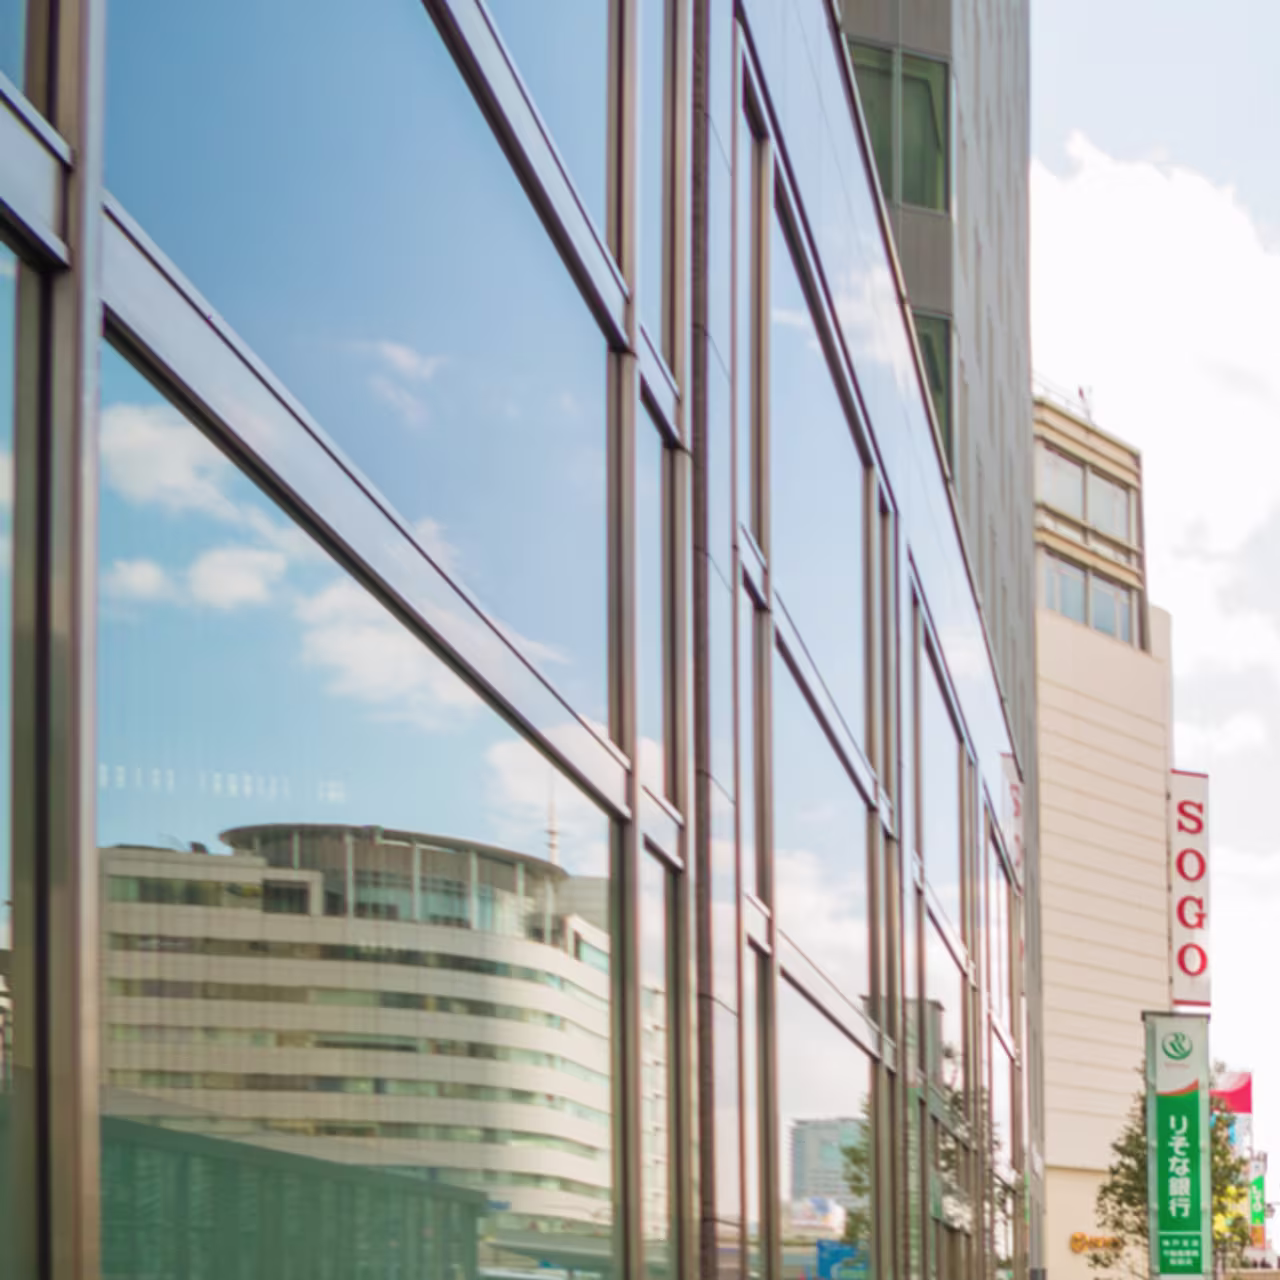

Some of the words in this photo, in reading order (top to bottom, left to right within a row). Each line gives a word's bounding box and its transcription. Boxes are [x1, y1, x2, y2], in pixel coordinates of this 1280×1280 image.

[1175, 800, 1208, 977] SOGO
[1167, 1114, 1191, 1218] りそな銀行
